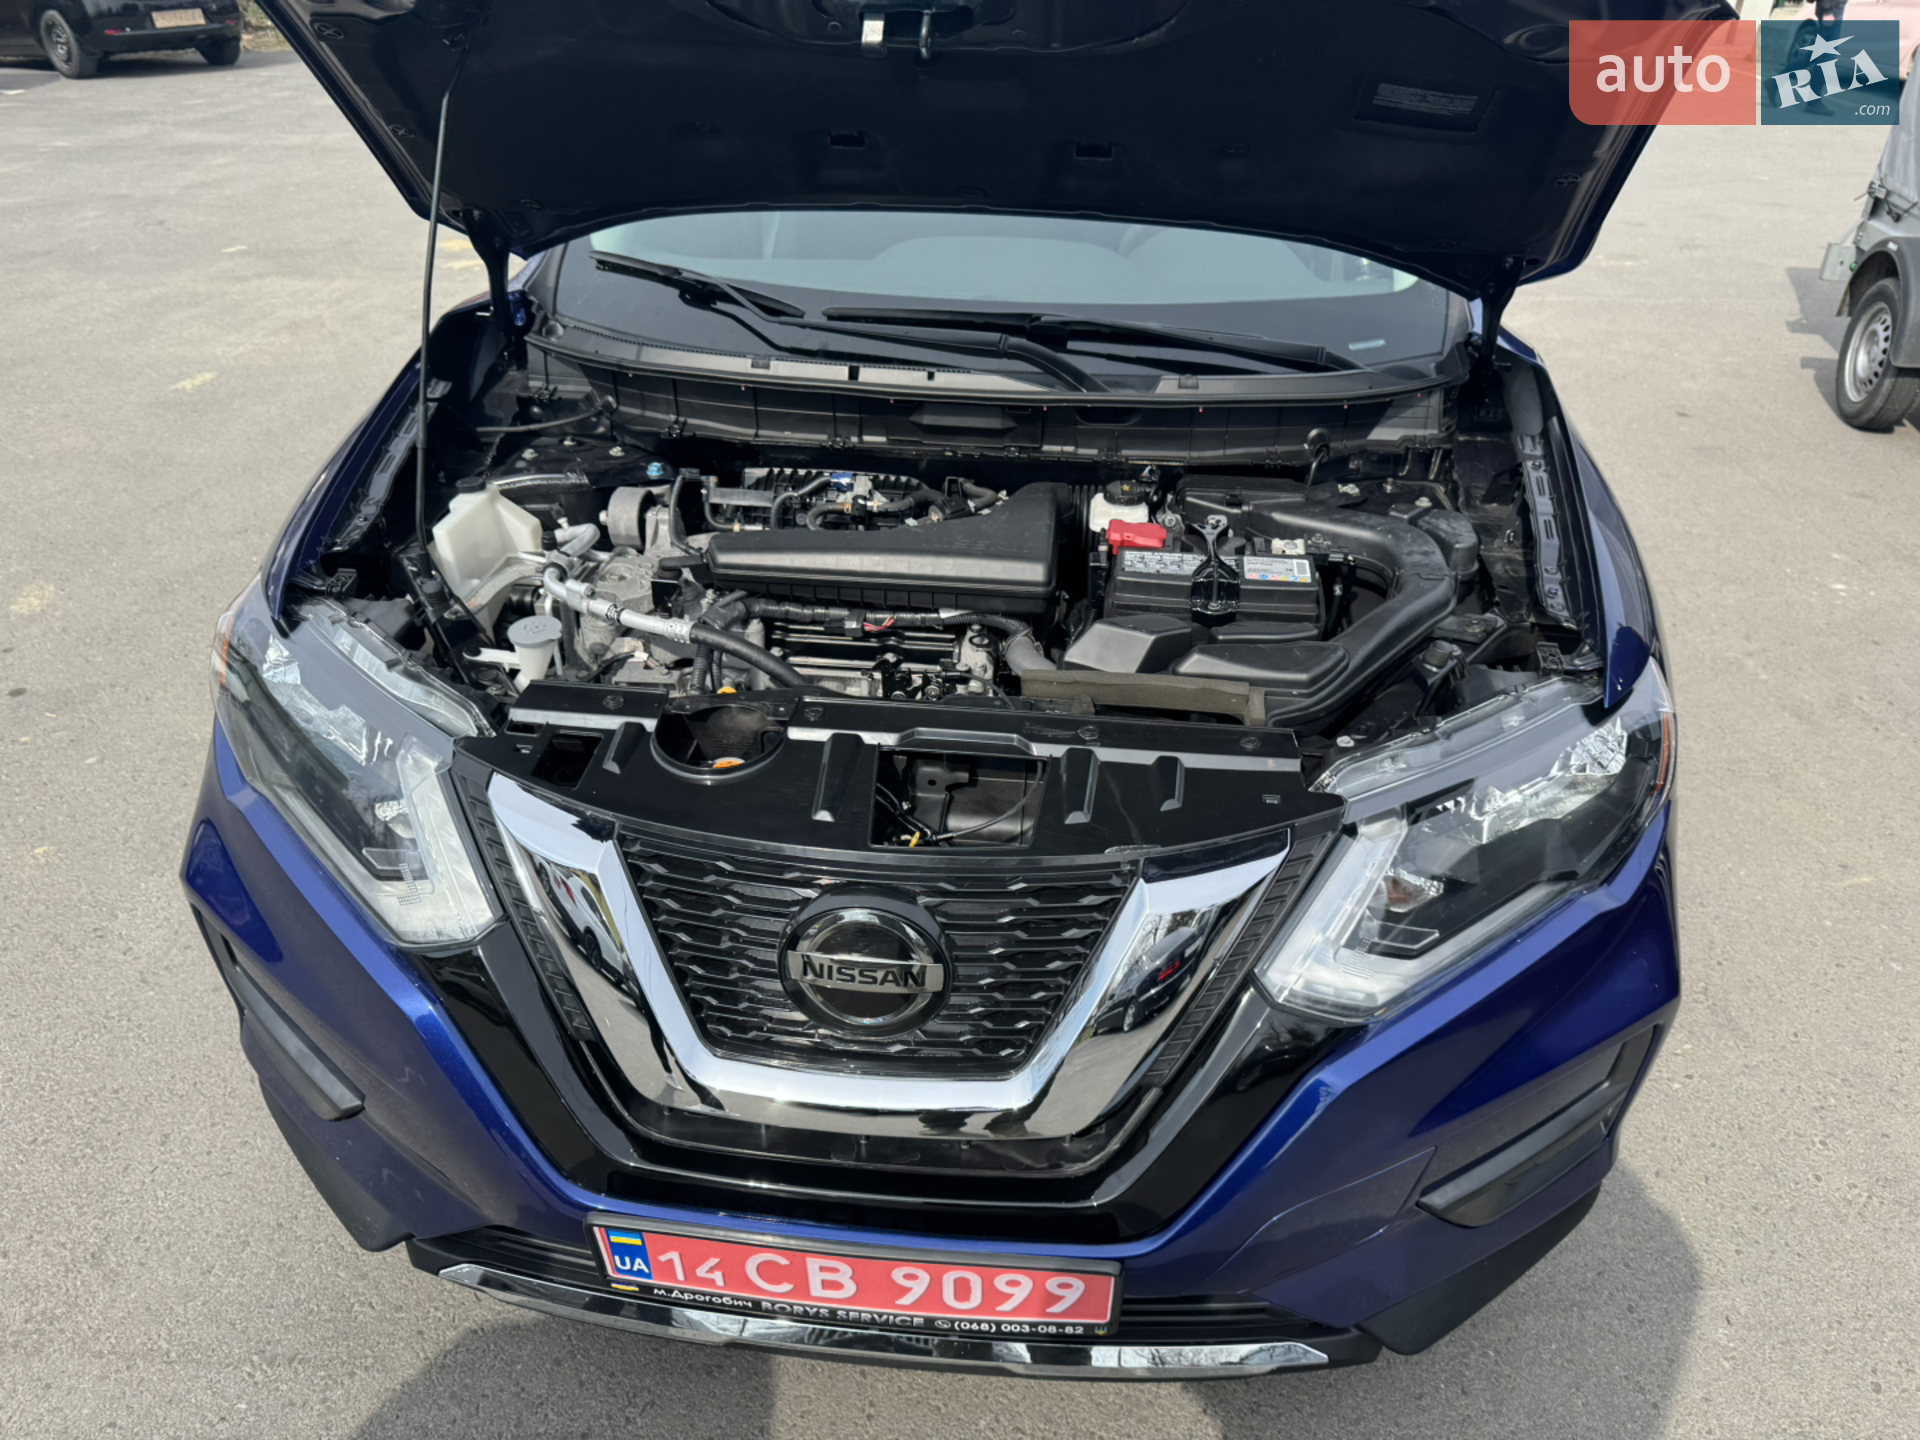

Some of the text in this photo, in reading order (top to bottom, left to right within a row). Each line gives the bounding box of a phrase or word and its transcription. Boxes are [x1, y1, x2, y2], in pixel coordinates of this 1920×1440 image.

[802, 954, 927, 987] NISSAN
[614, 1255, 650, 1274] UA
[657, 1251, 1086, 1314] 14 CB 9099
[761, 1300, 925, 1328] BORYS SERVICE
[953, 1321, 1084, 1335] (068) 003-08-82
